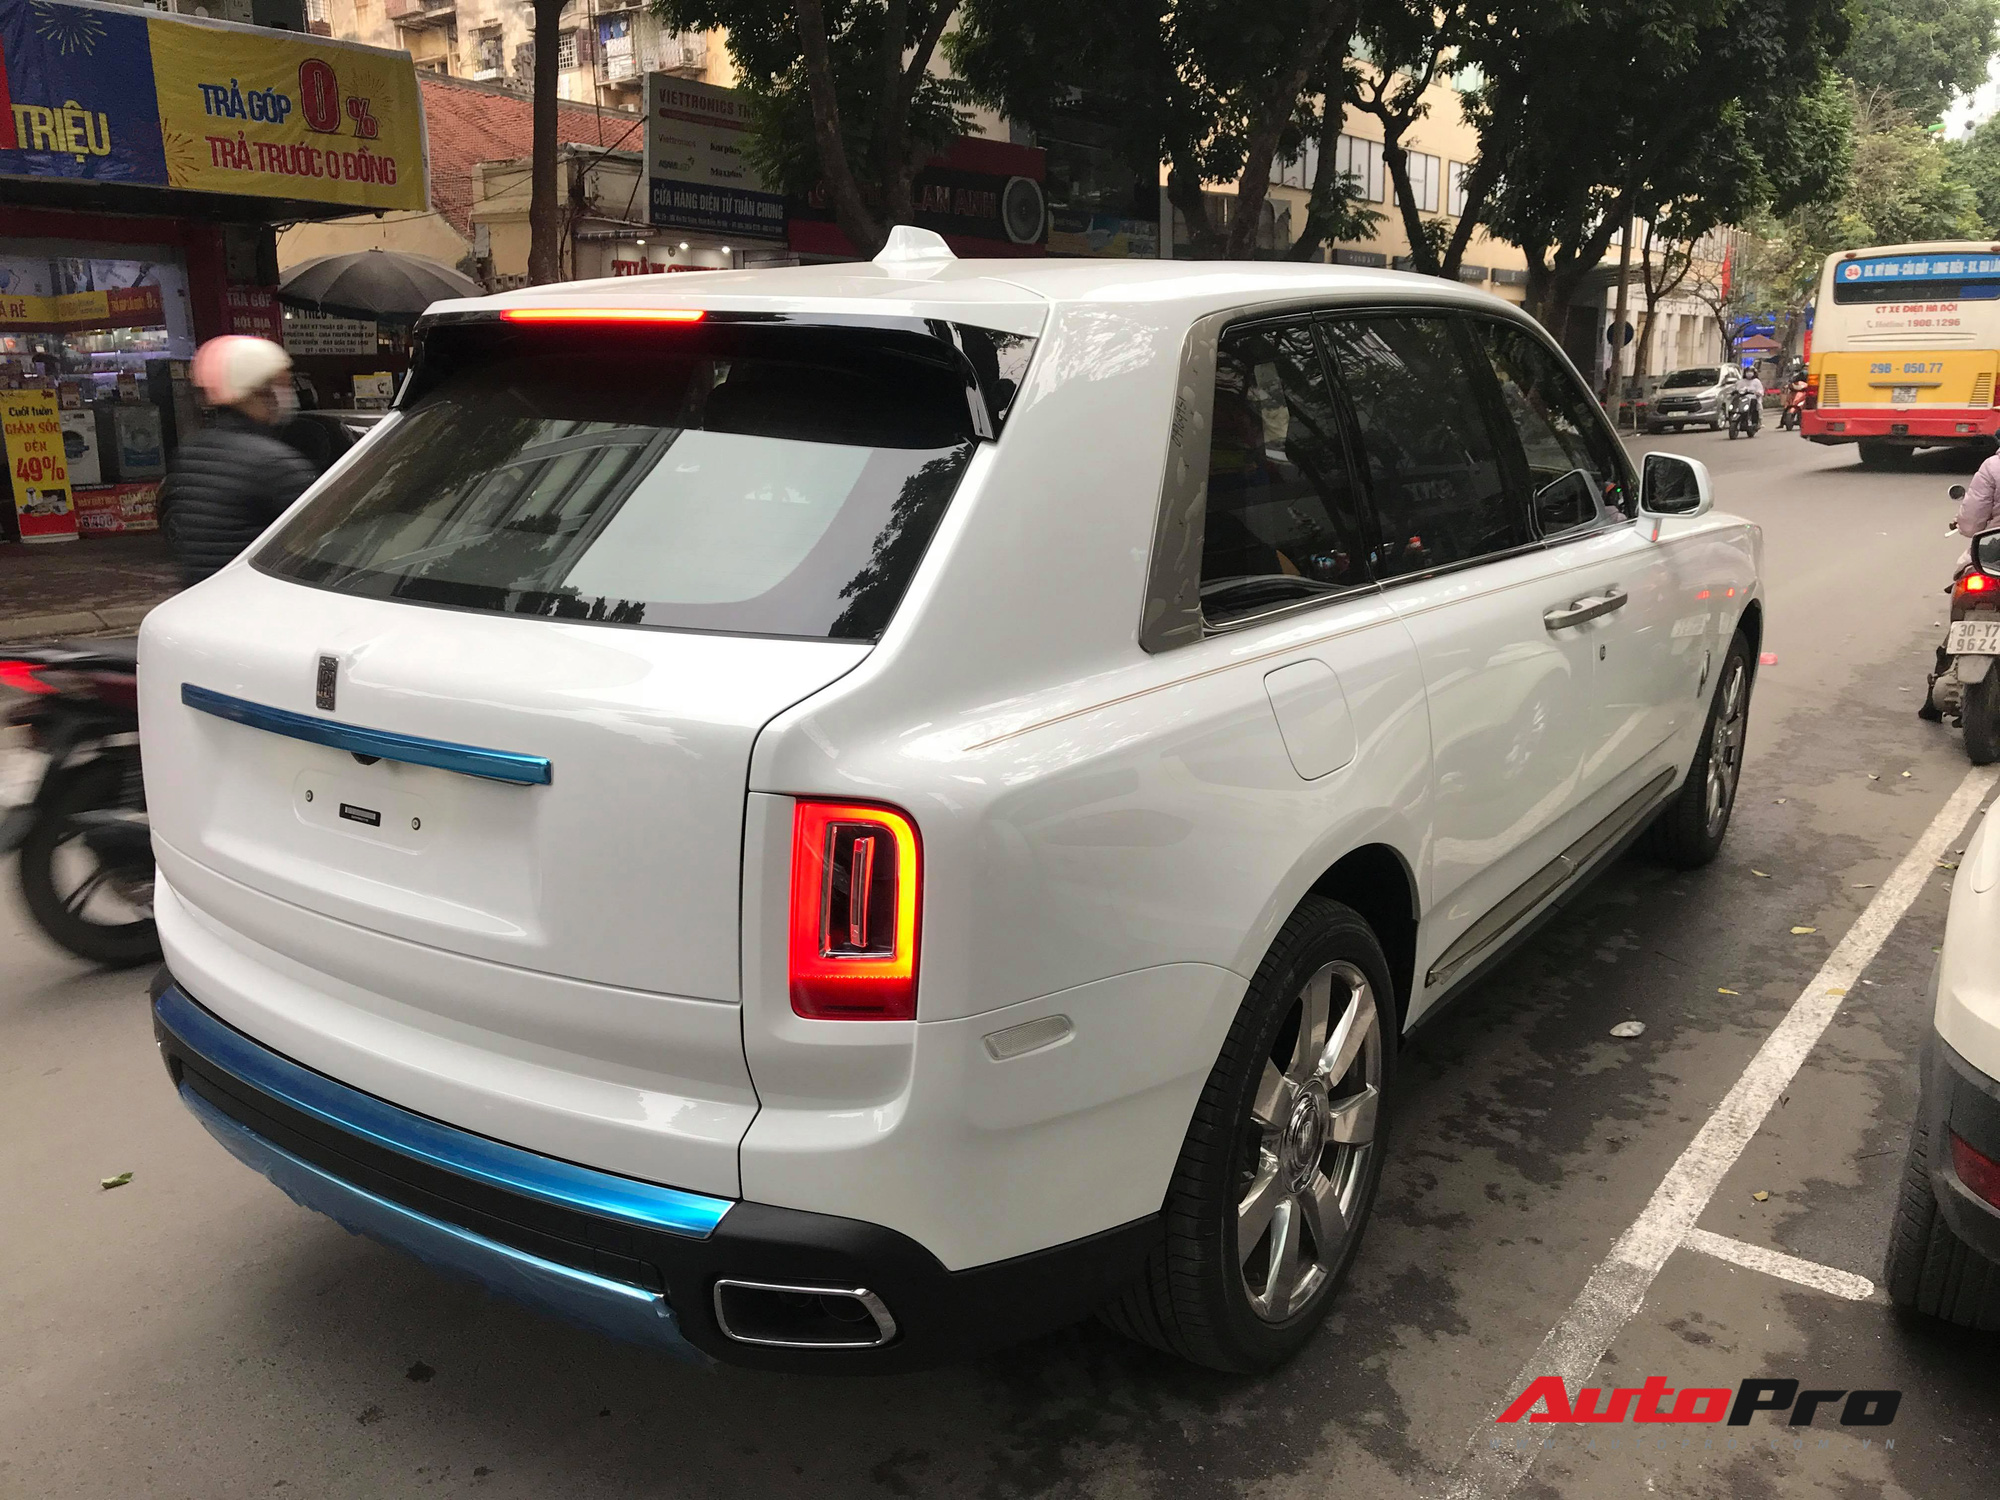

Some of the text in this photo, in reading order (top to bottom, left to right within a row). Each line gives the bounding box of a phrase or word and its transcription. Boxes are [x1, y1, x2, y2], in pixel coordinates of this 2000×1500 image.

[197, 77, 247, 120] TRẢ
[248, 87, 292, 124] GÓP
[658, 88, 734, 115] VIETTRONICS
[11, 99, 111, 163] TRIỆU
[205, 130, 254, 171] TRẢ
[253, 141, 323, 178] TRƯỚC
[342, 145, 397, 186] ĐỒNG
[653, 183, 672, 206] CỬA
[674, 188, 698, 210] HÀNG
[757, 201, 784, 220] CHUNG
[1889, 305, 1901, 313] XE
[1903, 362, 1944, 373] 050.77
[16, 456, 65, 482] 49%
[1956, 638, 1998, 652] 9624
